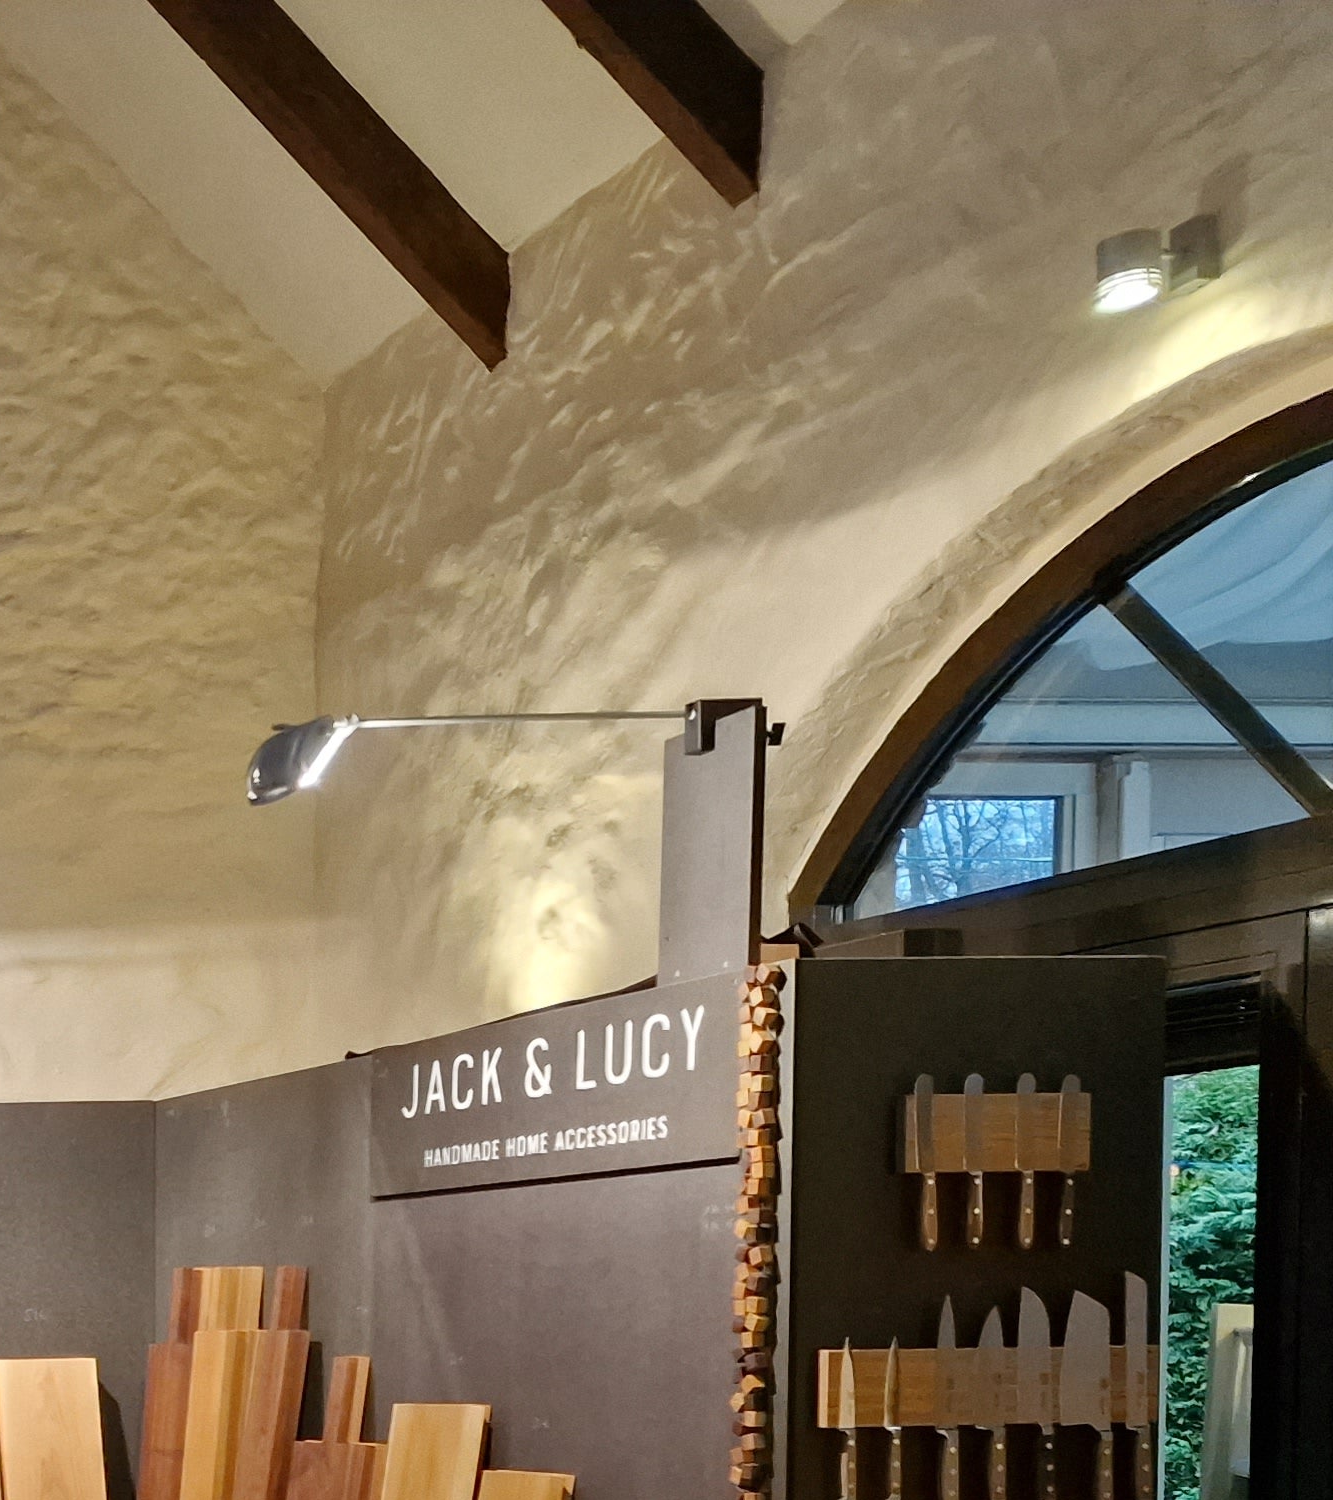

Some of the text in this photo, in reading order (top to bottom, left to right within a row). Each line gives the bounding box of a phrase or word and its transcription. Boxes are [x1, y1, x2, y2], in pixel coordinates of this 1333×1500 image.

[401, 1005, 705, 1119] JACK & LUCY
[423, 1116, 669, 1168] HANDMADE HOME ACCESSORIES
